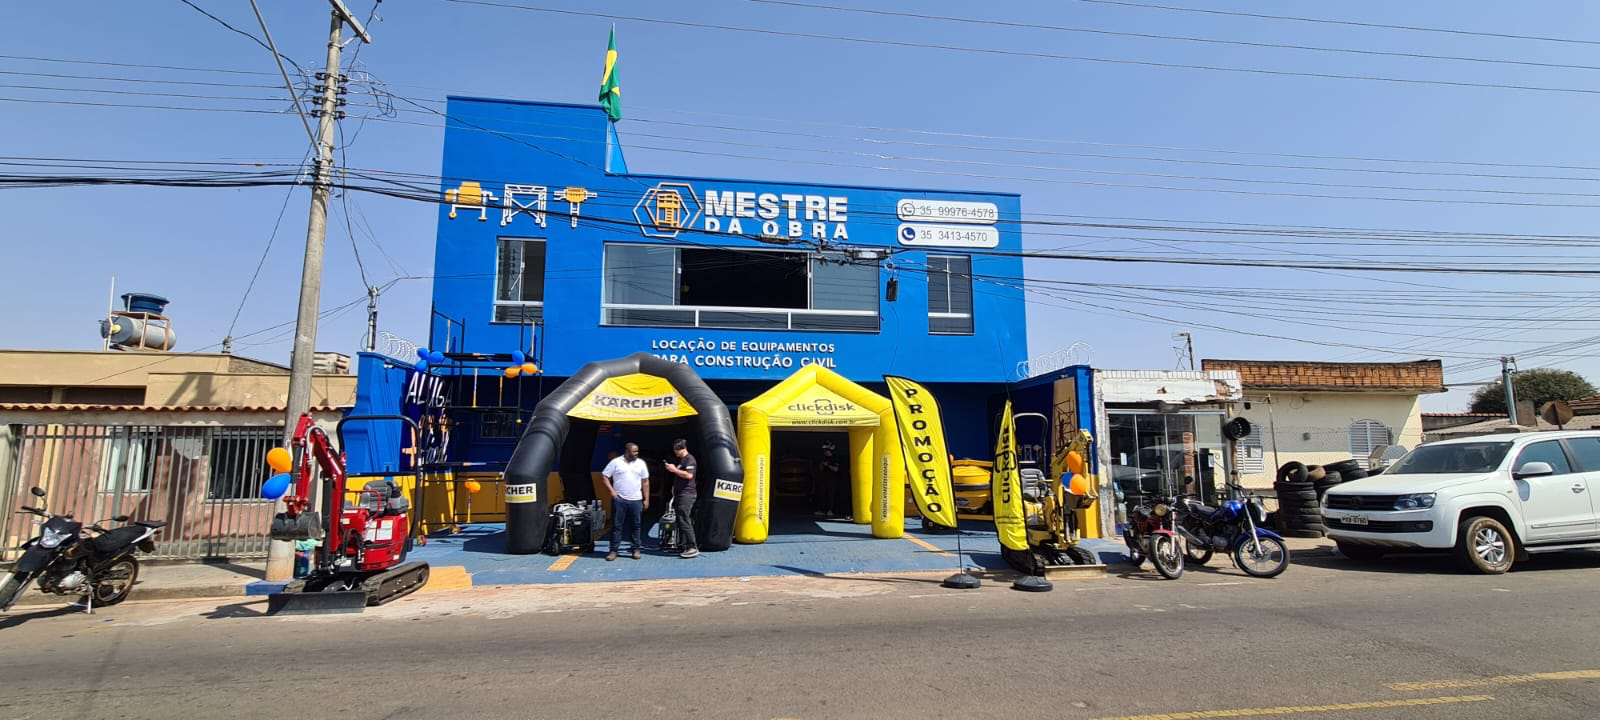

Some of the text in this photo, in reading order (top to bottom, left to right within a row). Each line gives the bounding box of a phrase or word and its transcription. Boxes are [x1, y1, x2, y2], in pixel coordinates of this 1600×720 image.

[704, 190, 848, 222] MESTRE
[920, 206, 995, 219] 35 99976-4578
[704, 217, 848, 240] DA OBRA
[920, 230, 988, 242] 35 3413-4570
[652, 337, 836, 354] LOCAÇÃO DE EQUIPAMENTOS
[695, 354, 793, 371] CONSTRUÇÃO
[595, 396, 674, 409] KÄRCHER
[787, 401, 857, 412] clickdisk
[904, 388, 943, 513] PROMOÇÃO
